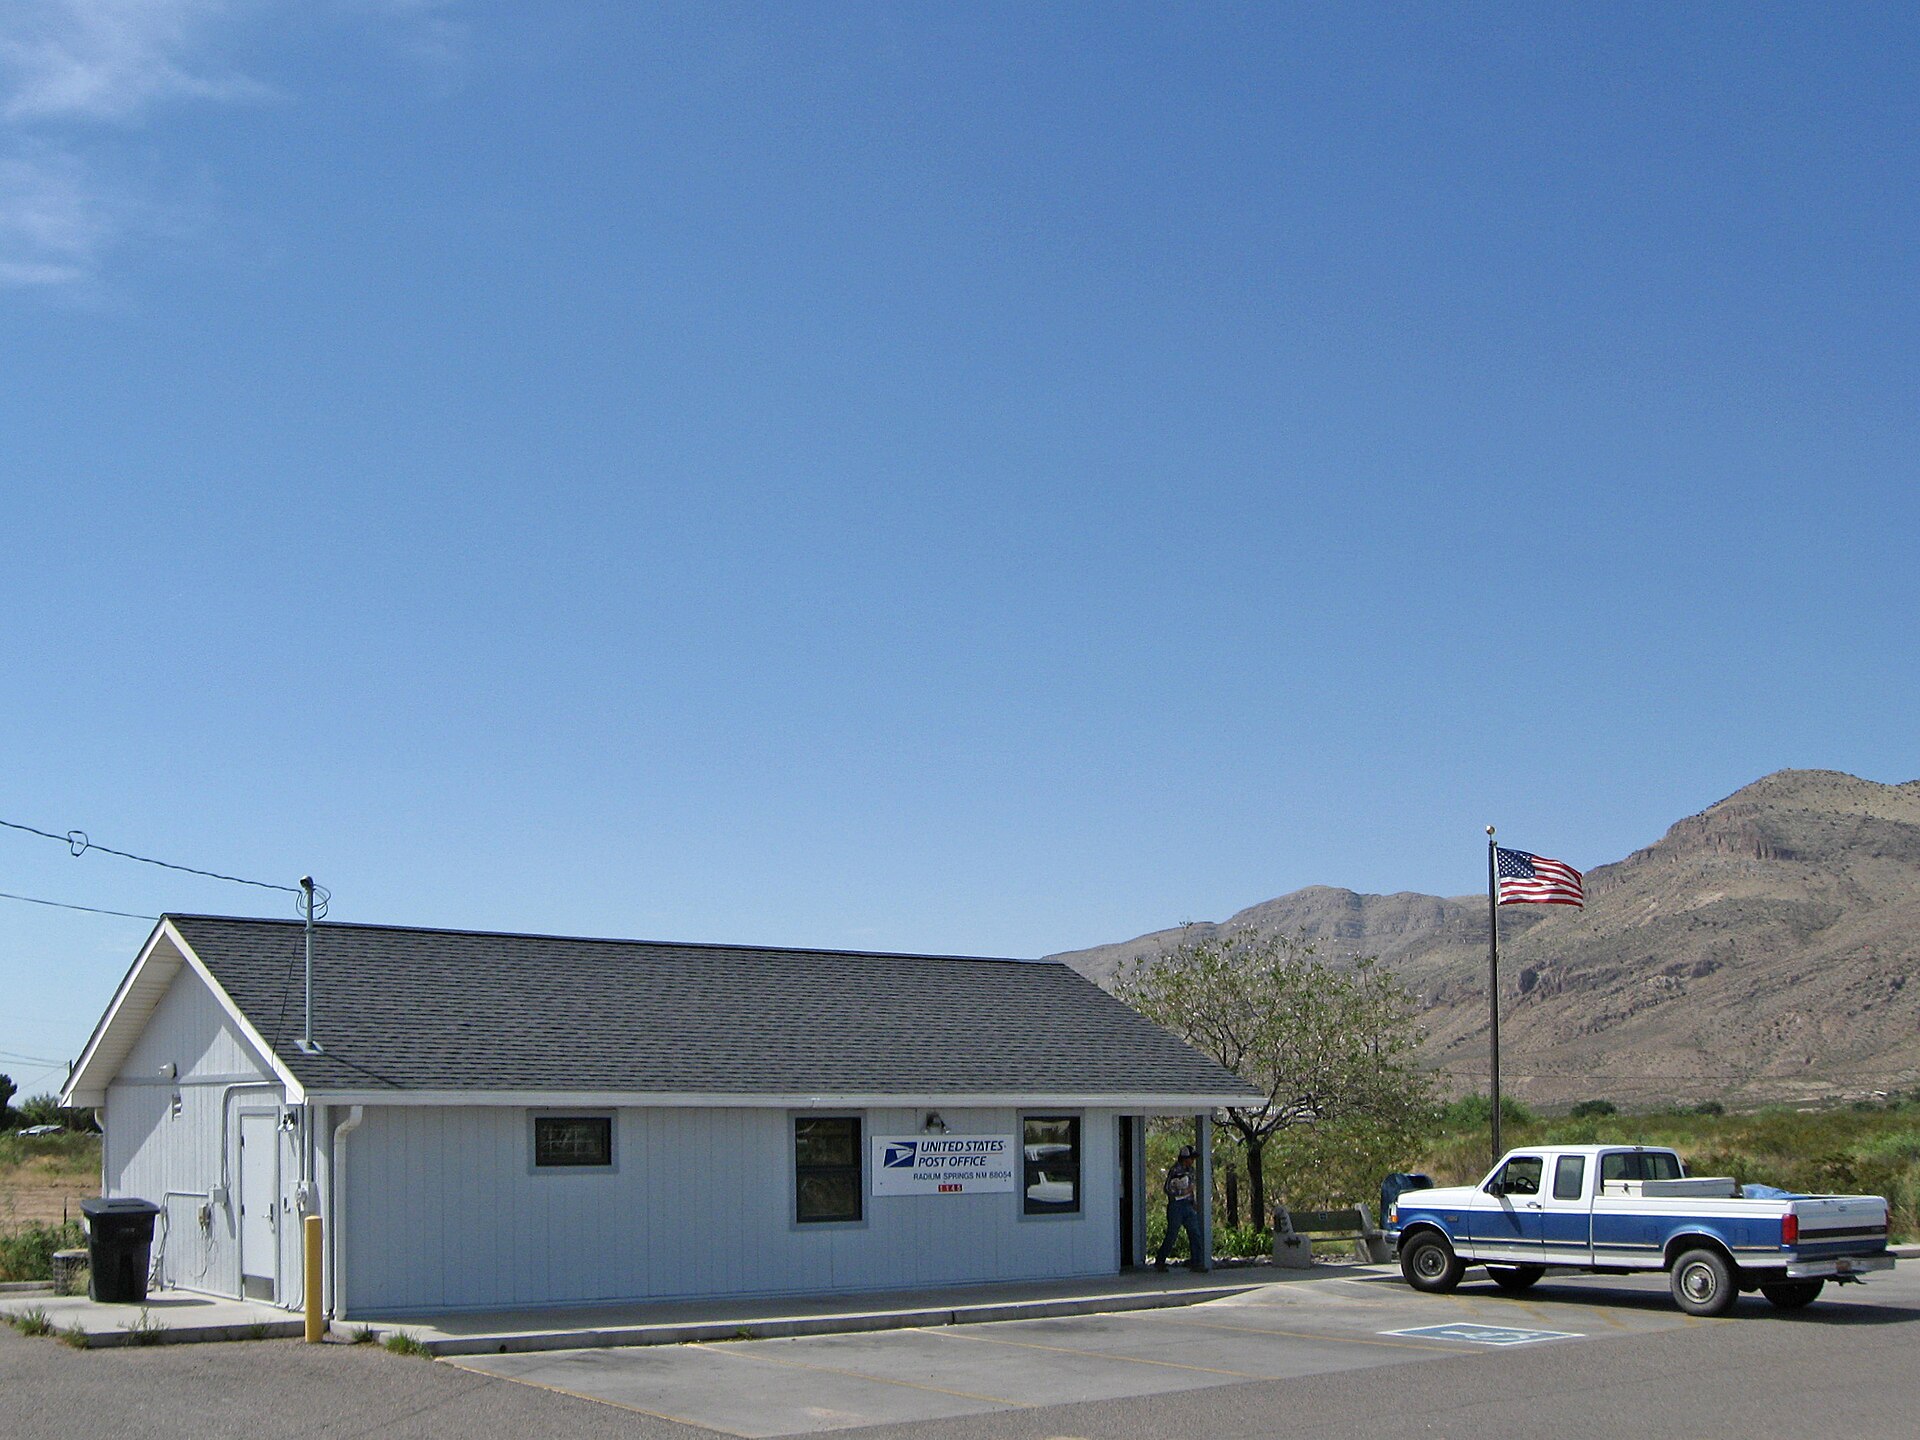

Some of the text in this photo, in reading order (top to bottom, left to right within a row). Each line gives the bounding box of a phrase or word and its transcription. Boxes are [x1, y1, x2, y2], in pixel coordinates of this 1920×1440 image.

[921, 1140, 1004, 1152] UNITED STATES
[918, 1156, 986, 1167] POST OFFICE
[913, 1172, 941, 1180] RADIUM
[943, 1171, 974, 1180] SPRINGS
[975, 1171, 987, 1179] NM
